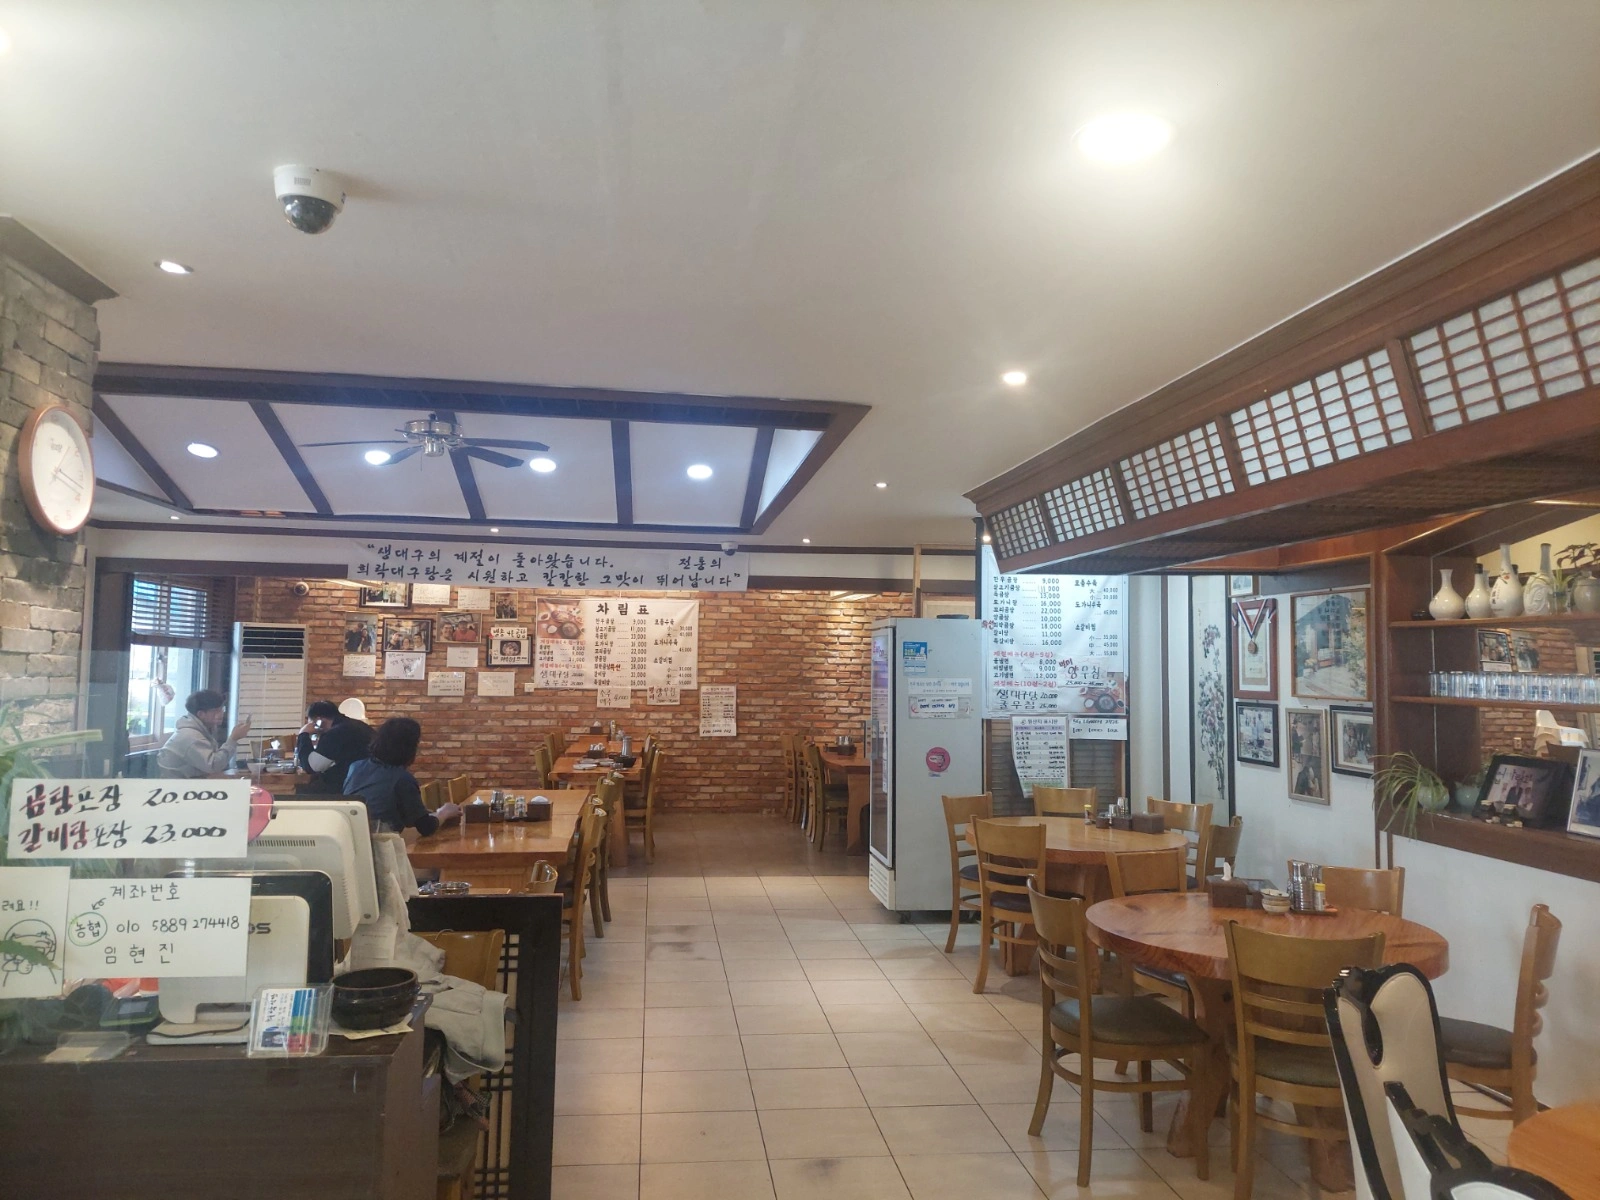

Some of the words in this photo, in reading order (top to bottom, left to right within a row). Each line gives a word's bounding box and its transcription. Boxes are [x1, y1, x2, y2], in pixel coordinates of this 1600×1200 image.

[454, 549, 500, 567] 계절이
[467, 569, 529, 584] 시원하고
[543, 570, 589, 587] 칼칼한
[142, 787, 229, 808] 20.000
[141, 824, 228, 844] 23.000
[109, 881, 181, 902] 계좌번호
[74, 921, 102, 939] 농협
[116, 922, 140, 935] 010
[151, 917, 187, 934] 5889
[192, 915, 241, 930] 274418
[104, 943, 174, 964] 임현진
